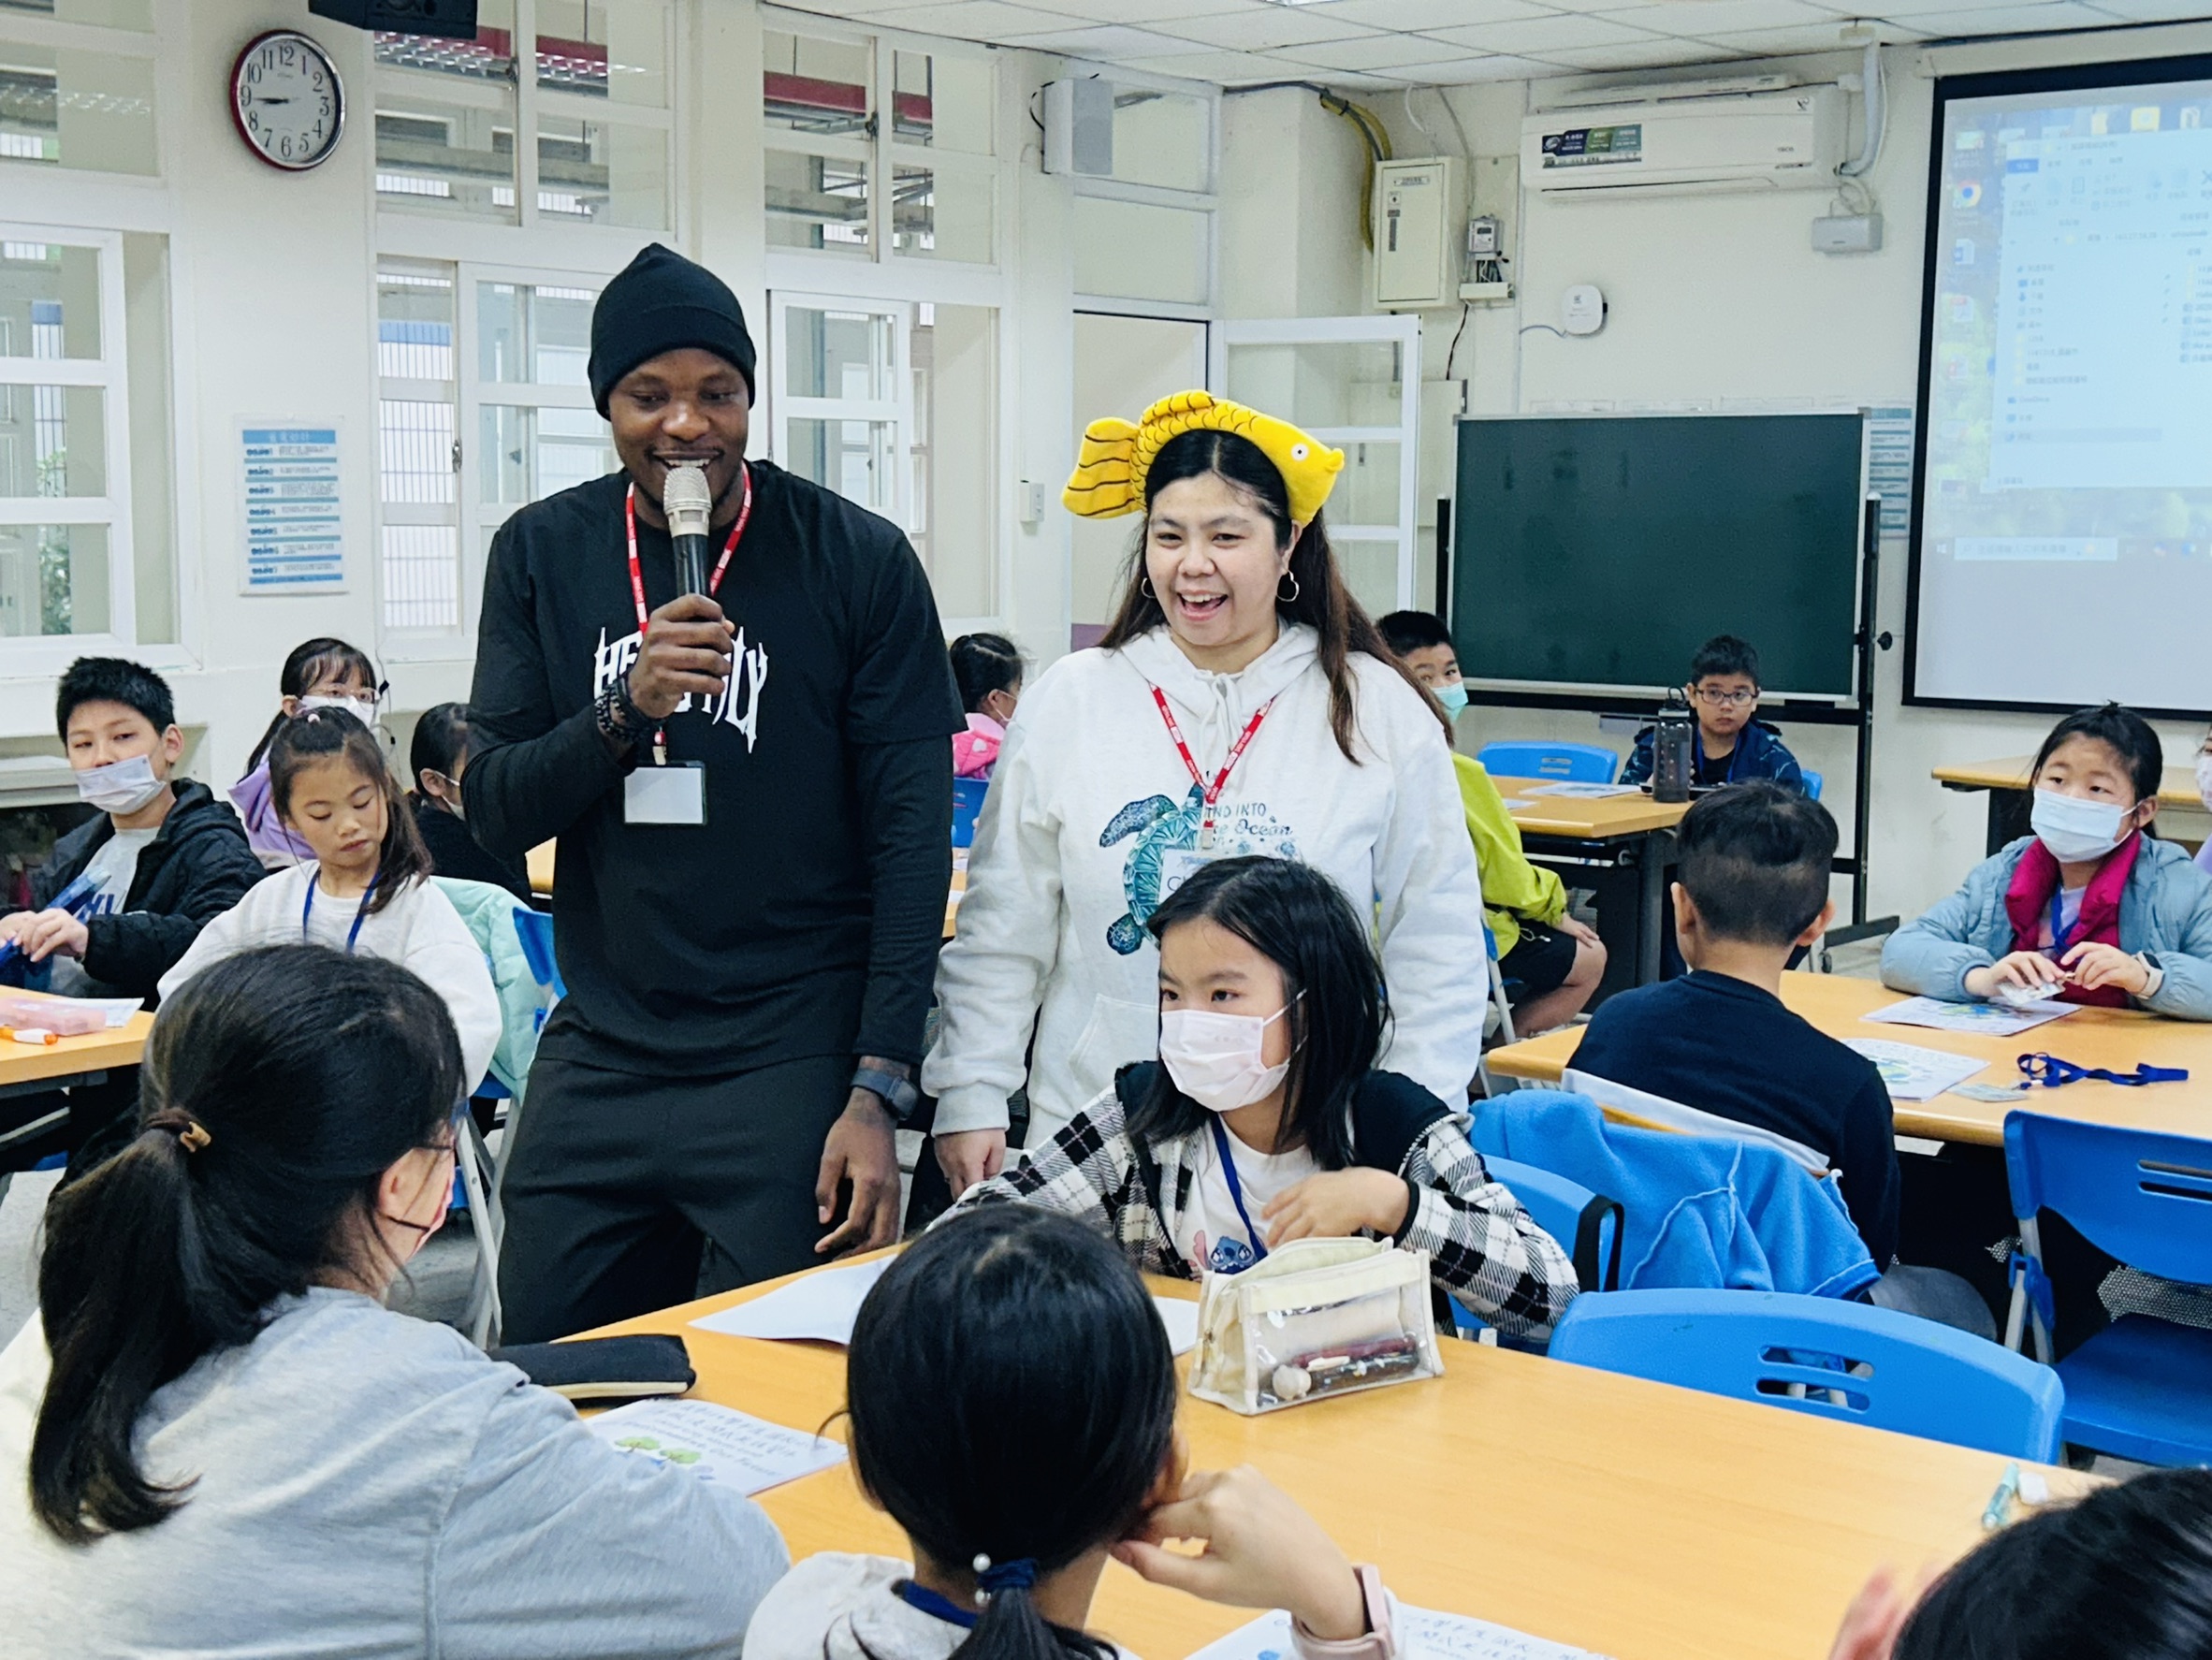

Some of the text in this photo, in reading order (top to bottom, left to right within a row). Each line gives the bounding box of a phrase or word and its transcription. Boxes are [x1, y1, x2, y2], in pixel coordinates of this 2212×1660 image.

[262, 49, 273, 70] 11
[280, 45, 294, 66] 12
[302, 55, 307, 76] 1
[247, 63, 262, 83] 10
[313, 71, 323, 93] 2
[240, 85, 252, 107] 9
[319, 95, 328, 116] 3
[249, 110, 258, 132] 8
[312, 119, 322, 139] 4
[264, 127, 273, 148] 7
[281, 136, 292, 157] 6
[298, 133, 309, 153] 5
[1235, 803, 1267, 817] INTO
[1235, 819, 1293, 835] Ocean
